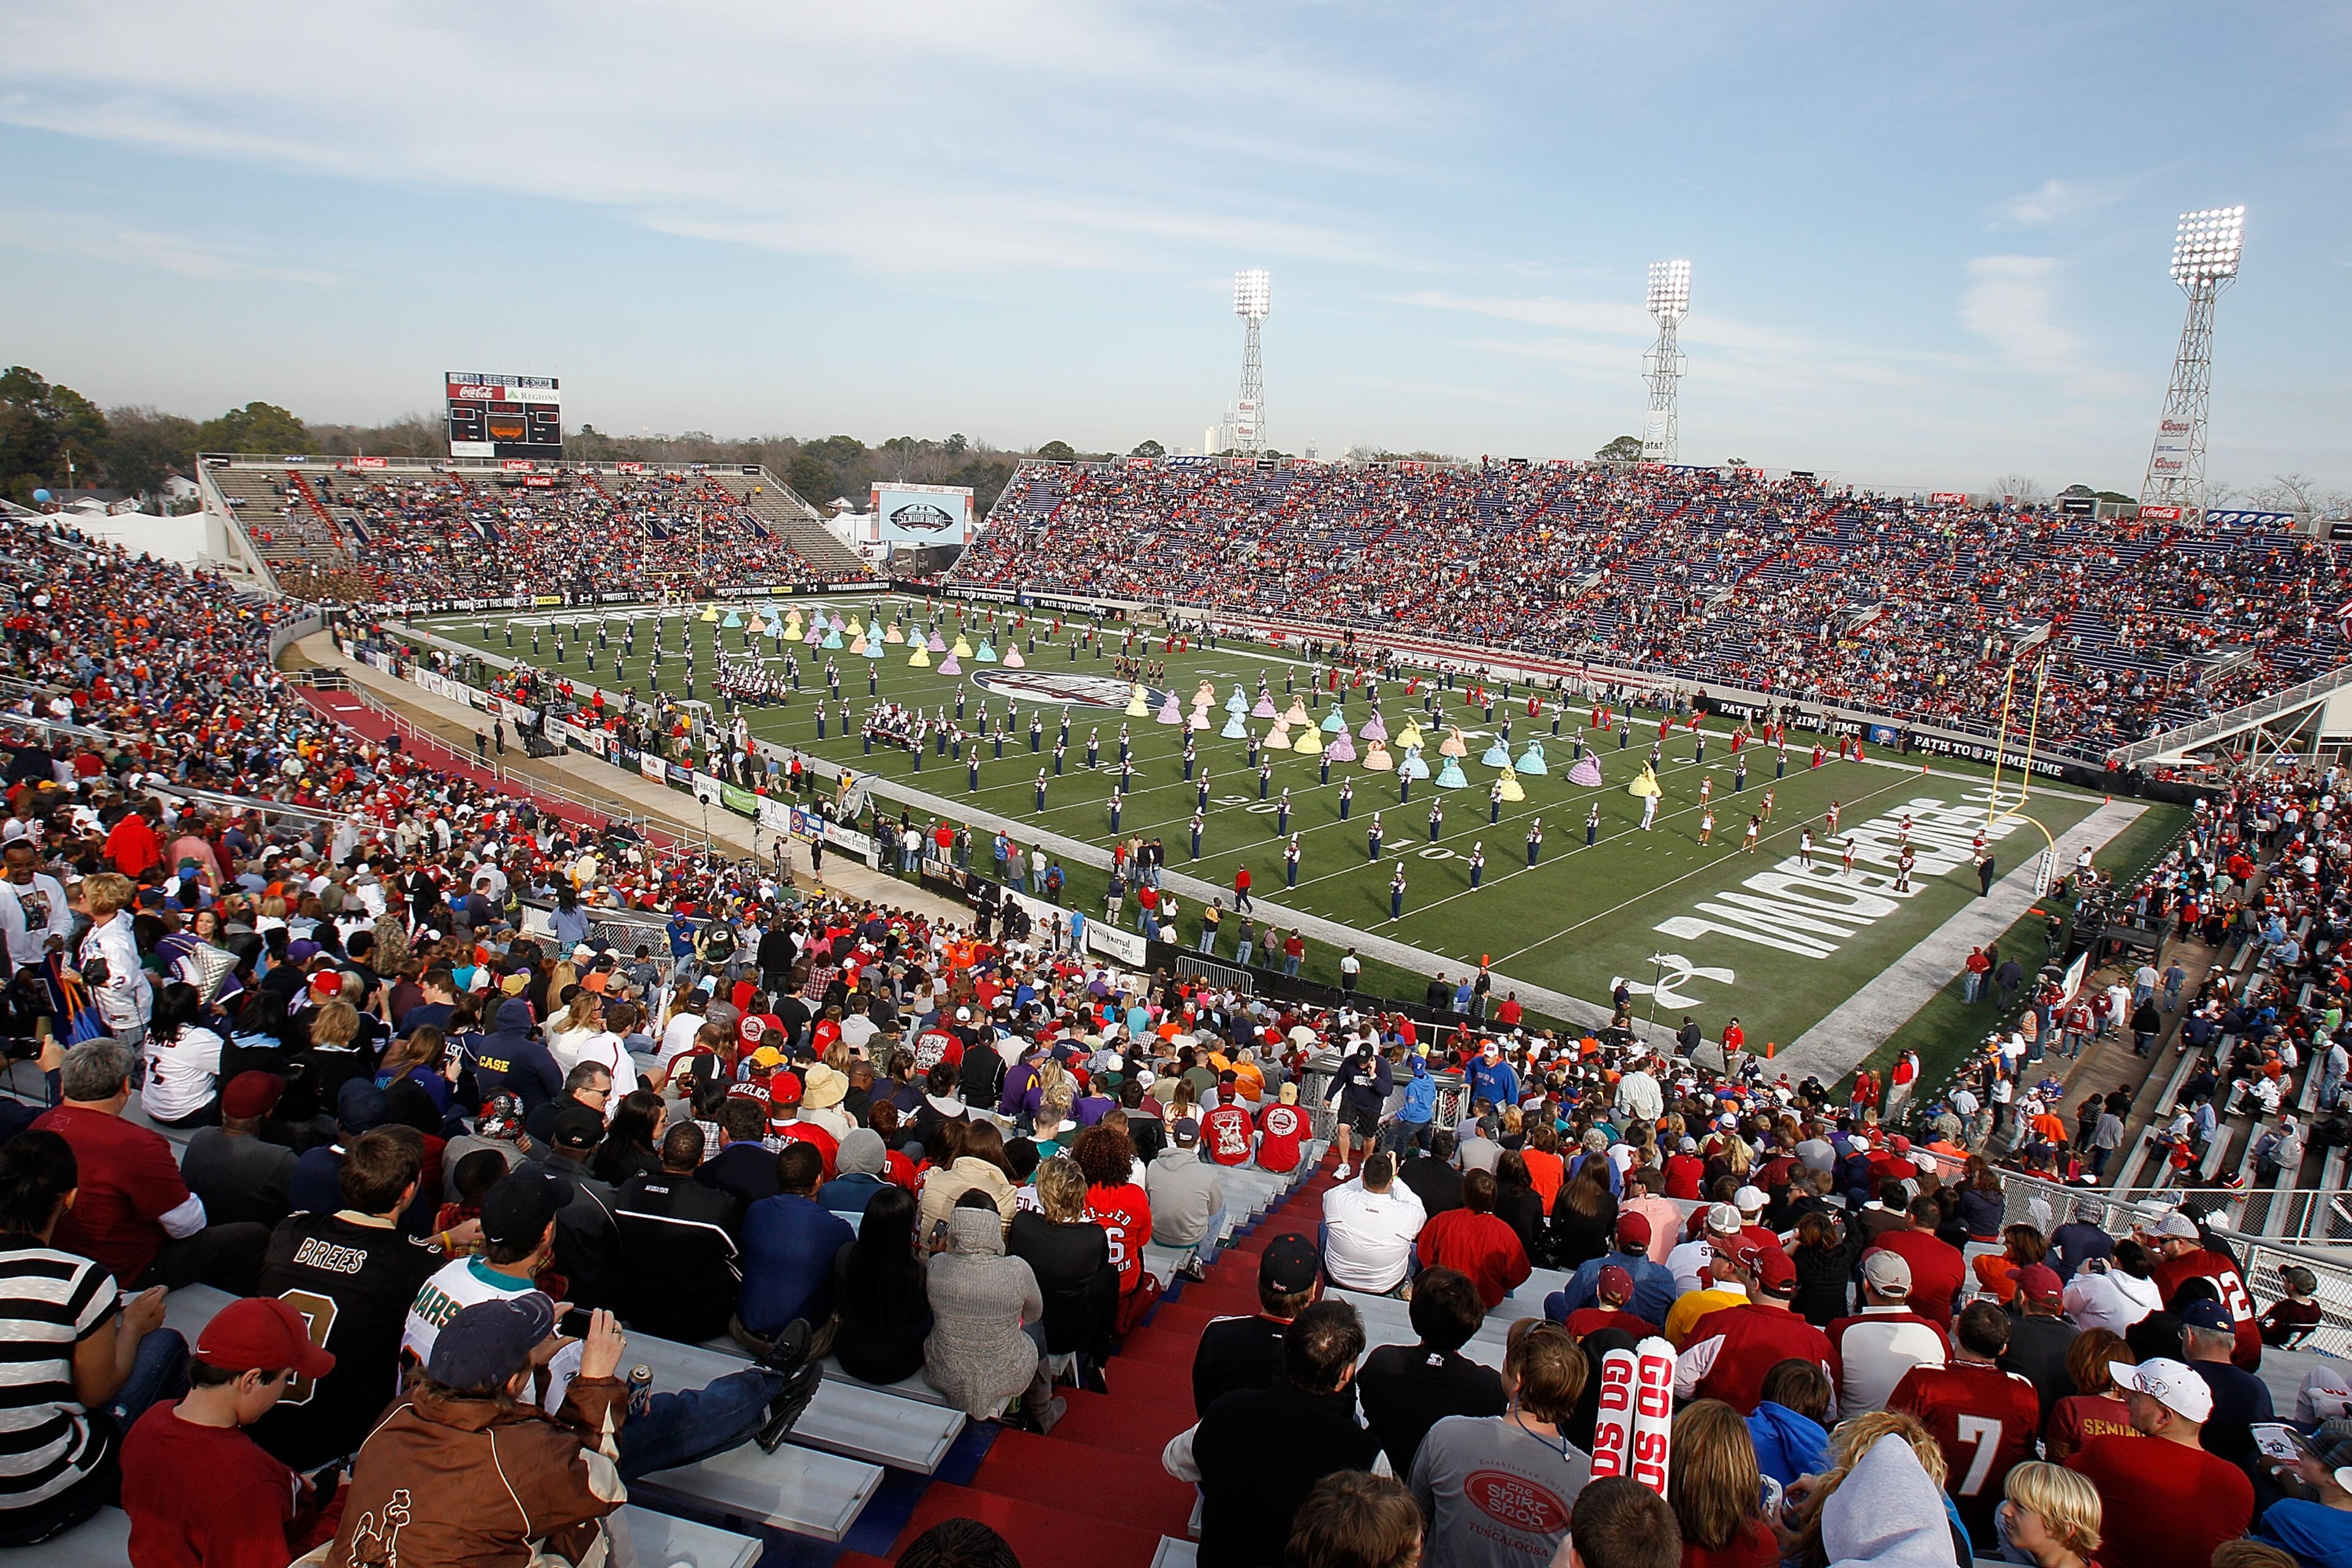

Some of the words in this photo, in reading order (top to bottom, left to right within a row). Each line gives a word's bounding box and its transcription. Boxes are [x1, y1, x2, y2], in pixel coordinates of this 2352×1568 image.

[2161, 420, 2190, 432] Coors
[1645, 441, 1664, 450] at&t
[2154, 457, 2183, 469] Coors
[899, 513, 925, 524] SENIOR
[925, 514, 944, 526] BOWL
[2146, 508, 2176, 518] Coca-Cola
[1914, 734, 1951, 752] PATH
[1953, 743, 1971, 756] TO
[1983, 748, 2064, 777] PRIMETIME
[1210, 795, 1280, 815] 20
[837, 831, 851, 844] State
[852, 835, 869, 850] Farm
[1381, 837, 1455, 860] 10
[712, 930, 729, 941] G
[478, 1055, 510, 1072] CASE
[729, 1082, 771, 1102] HERZLICH
[2021, 1104, 2035, 1115] 44
[293, 1237, 368, 1274] BREES
[1597, 1357, 1634, 1411] GO
[1636, 1354, 1672, 1419] GO
[1958, 1413, 2002, 1496] 7
[1468, 1521, 1548, 1557] TUSCALOOSA
